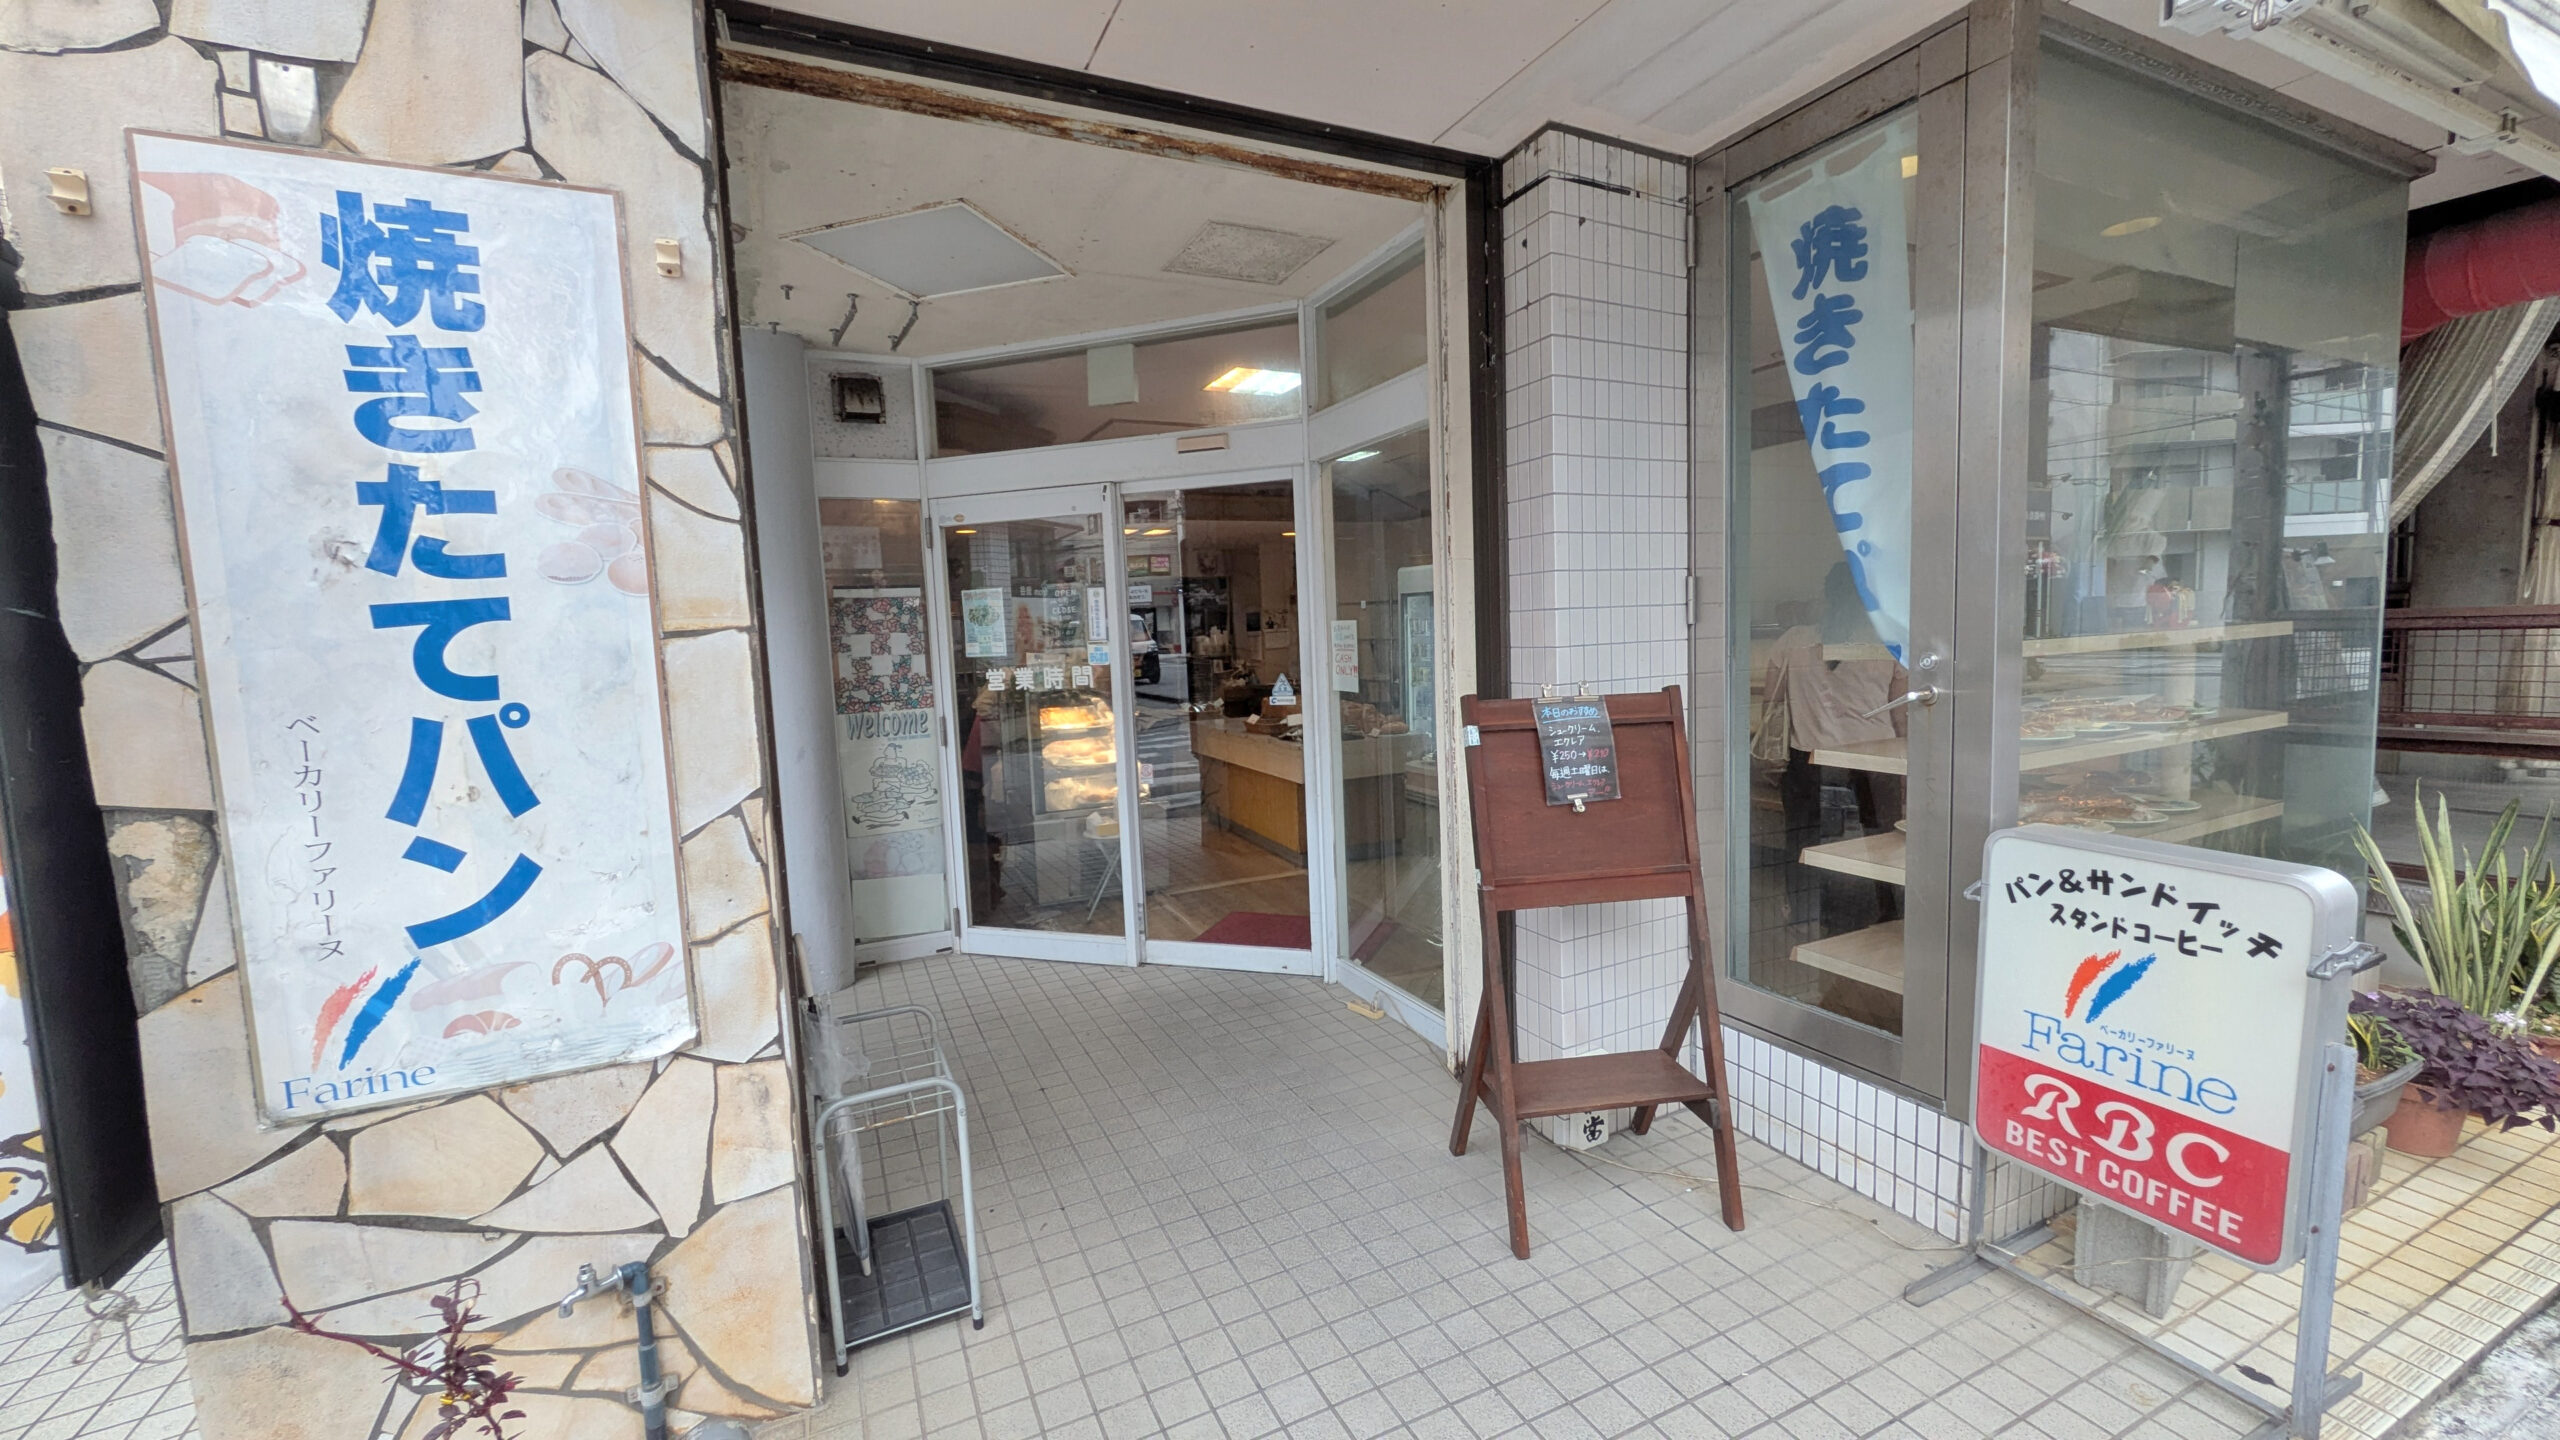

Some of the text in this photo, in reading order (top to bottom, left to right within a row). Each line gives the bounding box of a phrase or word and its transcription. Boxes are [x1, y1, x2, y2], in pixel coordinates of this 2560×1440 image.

[320, 190, 543, 949] 焼きたてパン
[985, 665, 1094, 692] 営業時間
[846, 710, 929, 740] Welcome
[1541, 705, 1599, 719] 本日のおすすめ
[1554, 735, 1585, 747] エクレア
[285, 715, 345, 960] ベーカリーファリーヌ
[2004, 868, 2284, 960] パン&サンドイッチ
[2049, 902, 2225, 957] スタンドコーヒー
[2022, 1009, 2239, 1116] Farine
[2099, 1024, 2197, 1060] ベーカリーファリーヌ
[281, 1064, 436, 1111] Farine
[2022, 1073, 2231, 1188] RBC
[2005, 1120, 2244, 1245] BEST COFFEE
